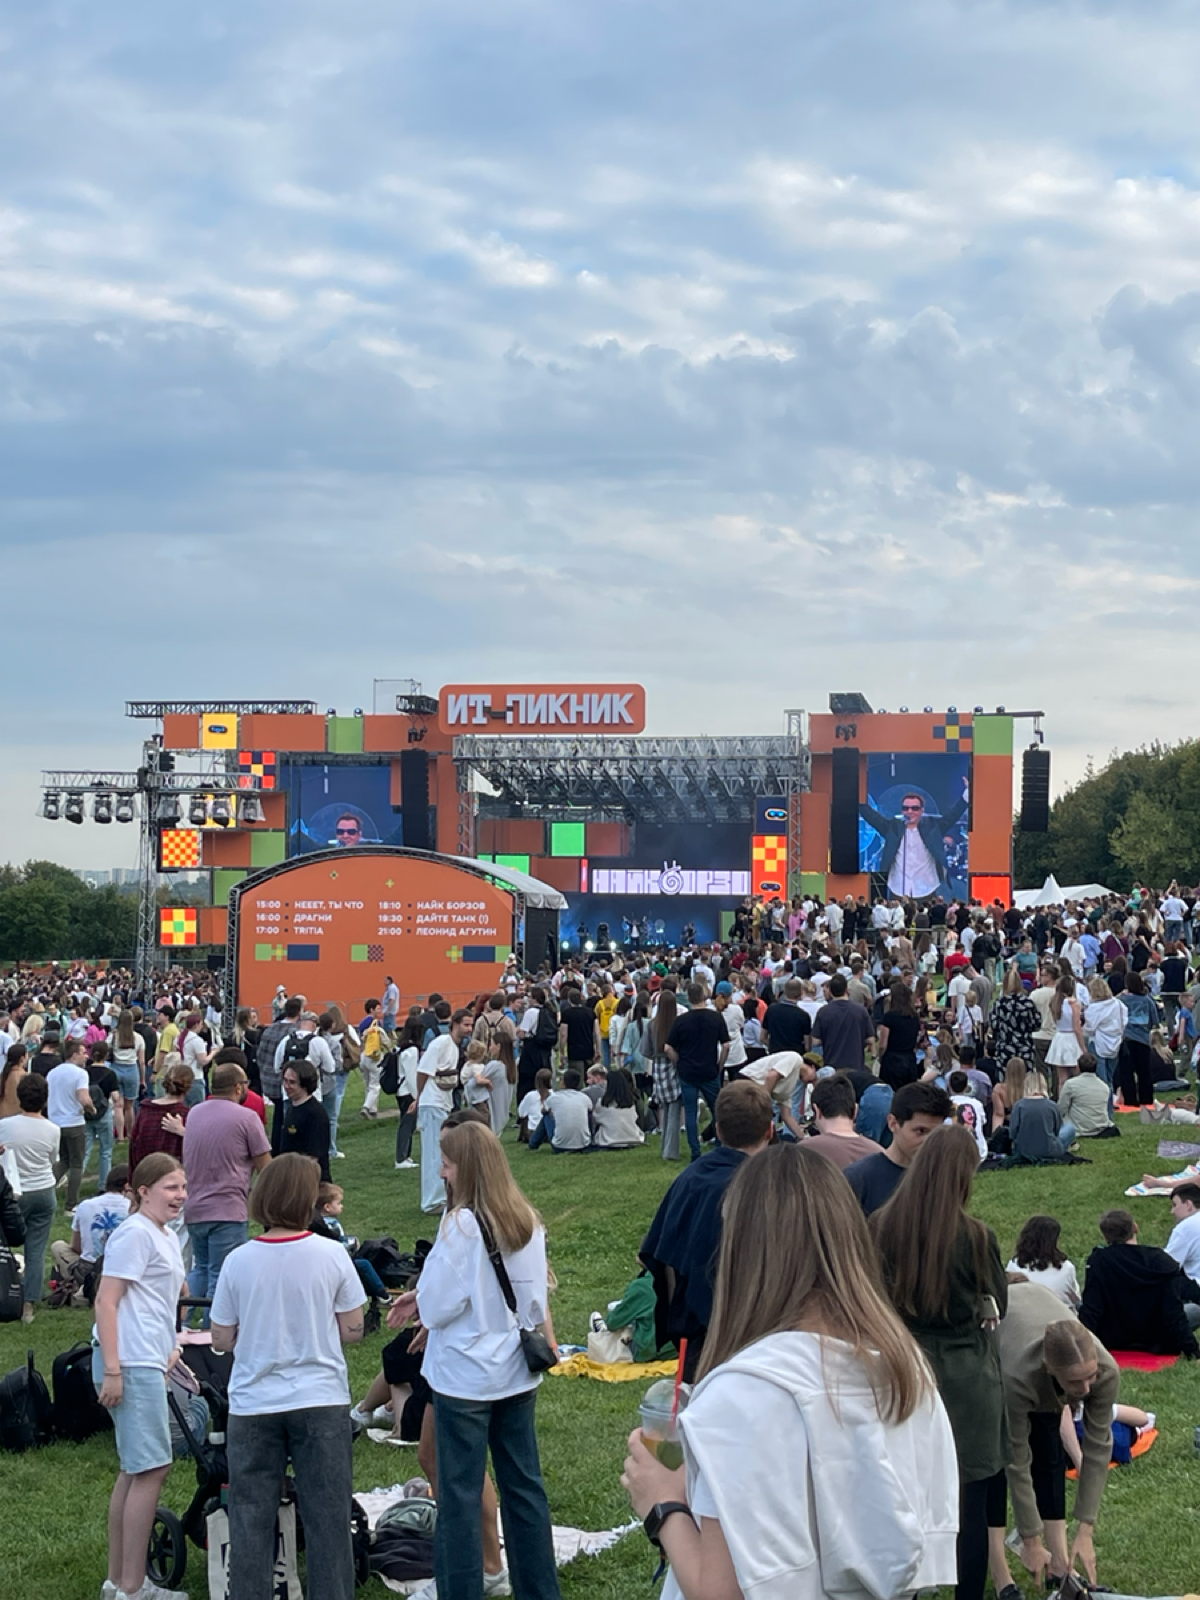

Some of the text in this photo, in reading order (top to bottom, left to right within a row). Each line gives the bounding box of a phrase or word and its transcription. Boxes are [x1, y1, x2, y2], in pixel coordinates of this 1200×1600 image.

[255, 900, 364, 911] 15:00 НЕЕЕТ, ТЫ ЧТО
[378, 899, 486, 910] 18:10 НАЙК БОРЗОВ
[255, 913, 332, 924] 16:00 ДРАГНИ
[378, 912, 489, 925] 19:30 ДАЙТЕ ТАНК (!)
[255, 926, 324, 935] 17:00 TRITIA
[377, 927, 497, 938] 21:00 ЛЕОНИД АГУТИН
